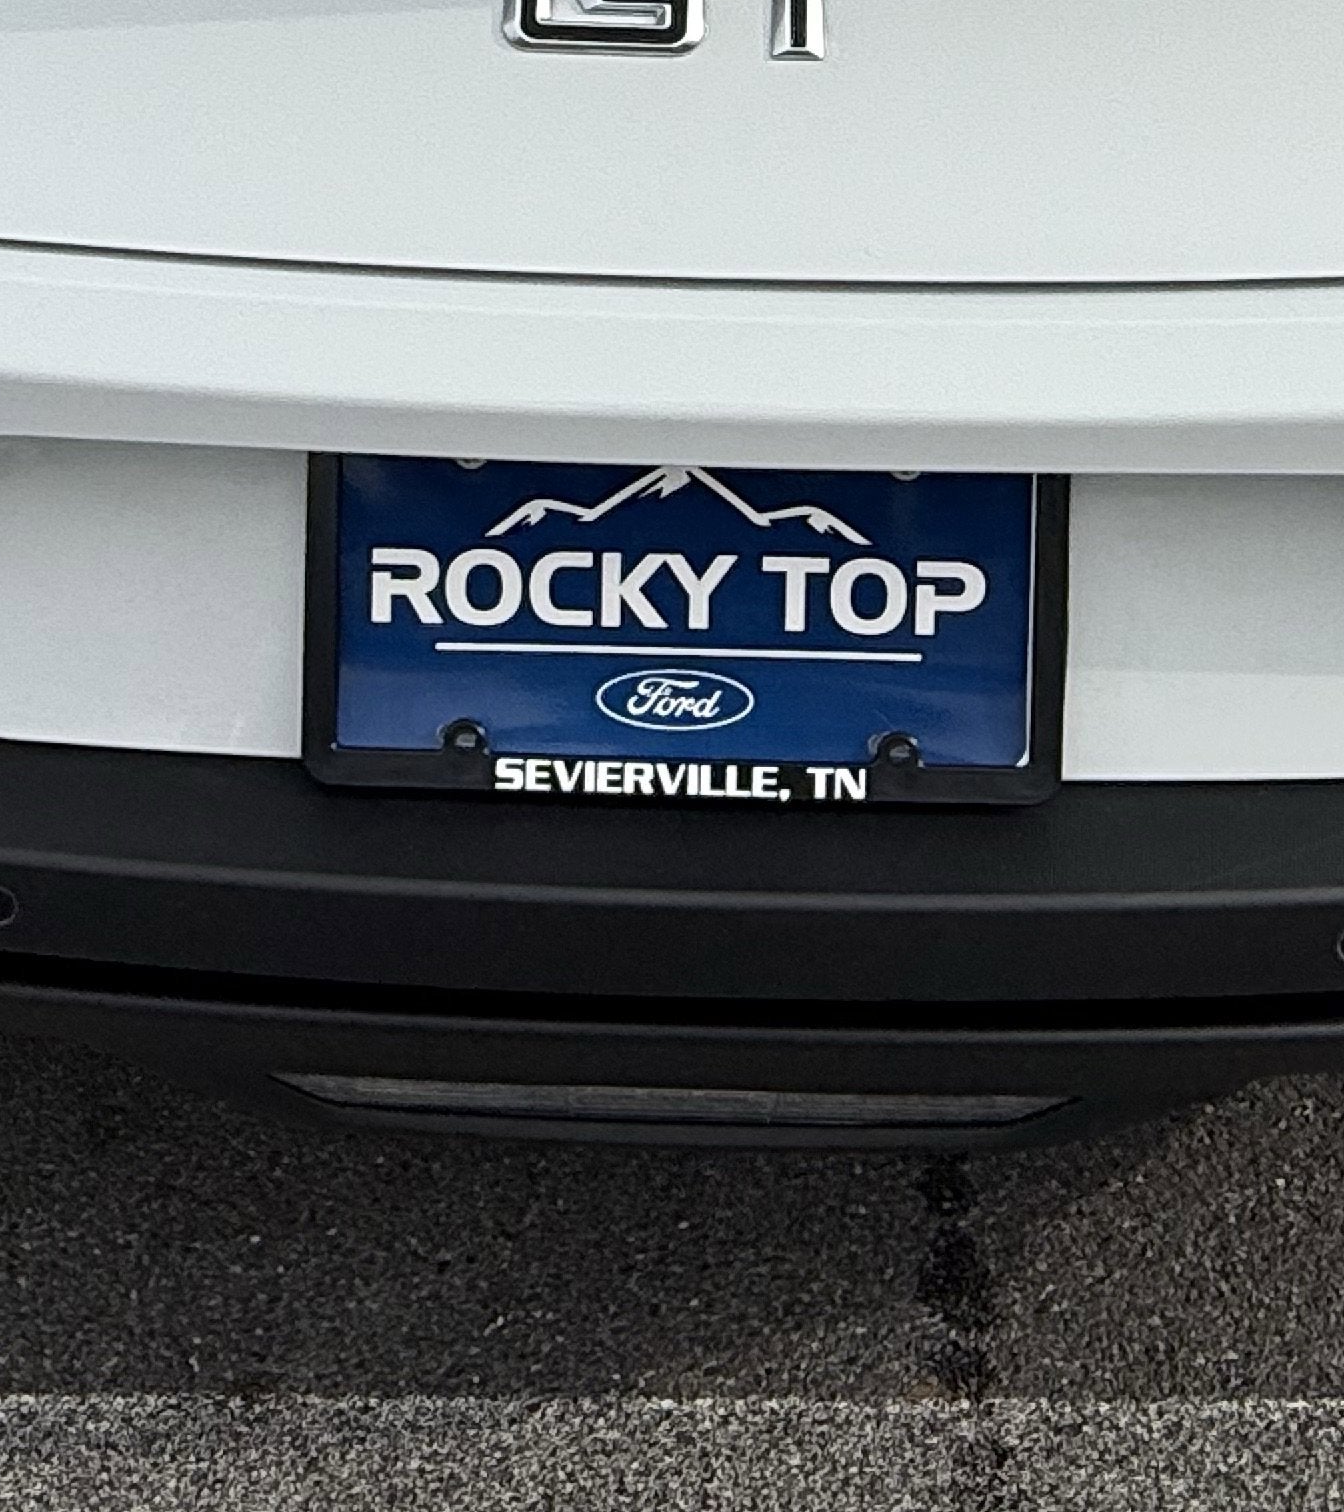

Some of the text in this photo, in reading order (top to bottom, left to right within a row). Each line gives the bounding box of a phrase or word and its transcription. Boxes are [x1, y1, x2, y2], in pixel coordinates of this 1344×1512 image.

[369, 547, 987, 636] ROCKY TOP
[626, 677, 724, 718] Ford
[494, 757, 867, 803] SEVIERVILLE, TN
